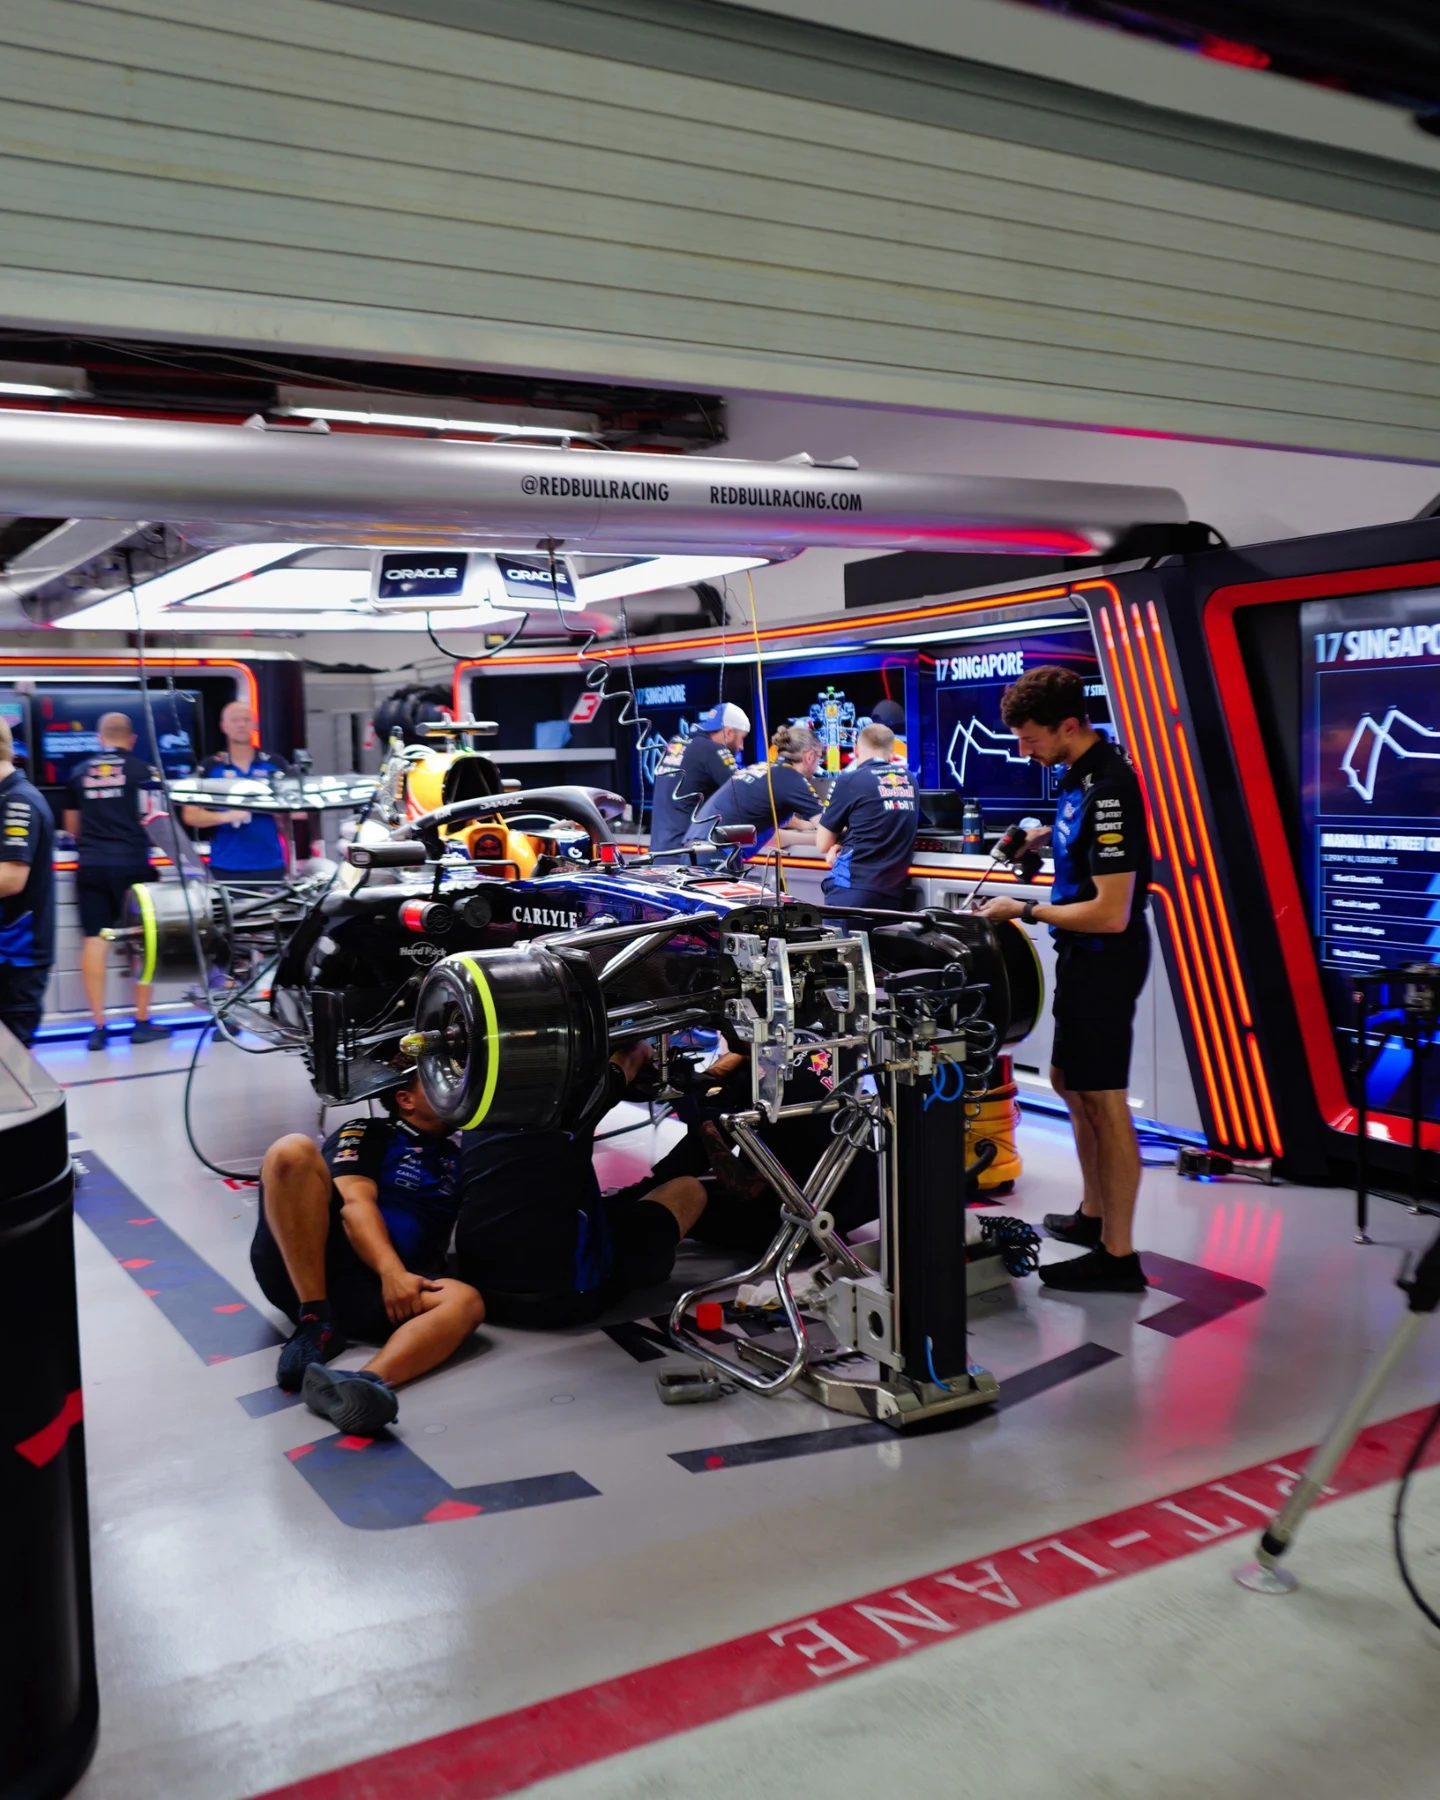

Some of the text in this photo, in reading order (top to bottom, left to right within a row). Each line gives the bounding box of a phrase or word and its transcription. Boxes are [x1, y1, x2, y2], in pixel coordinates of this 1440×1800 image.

[521, 475, 862, 511] @REDBULLRACING REDBULLRACING.COM
[384, 567, 458, 580] ORACLE
[1315, 632, 1344, 663] 17
[935, 651, 1024, 682] 17 SINGAPORE
[645, 684, 686, 705] SINGAPORE
[1096, 799, 1120, 808] VISA
[1095, 822, 1123, 831] ROKT
[512, 906, 578, 929] CARLYLE
[399, 947, 424, 956] Hard
